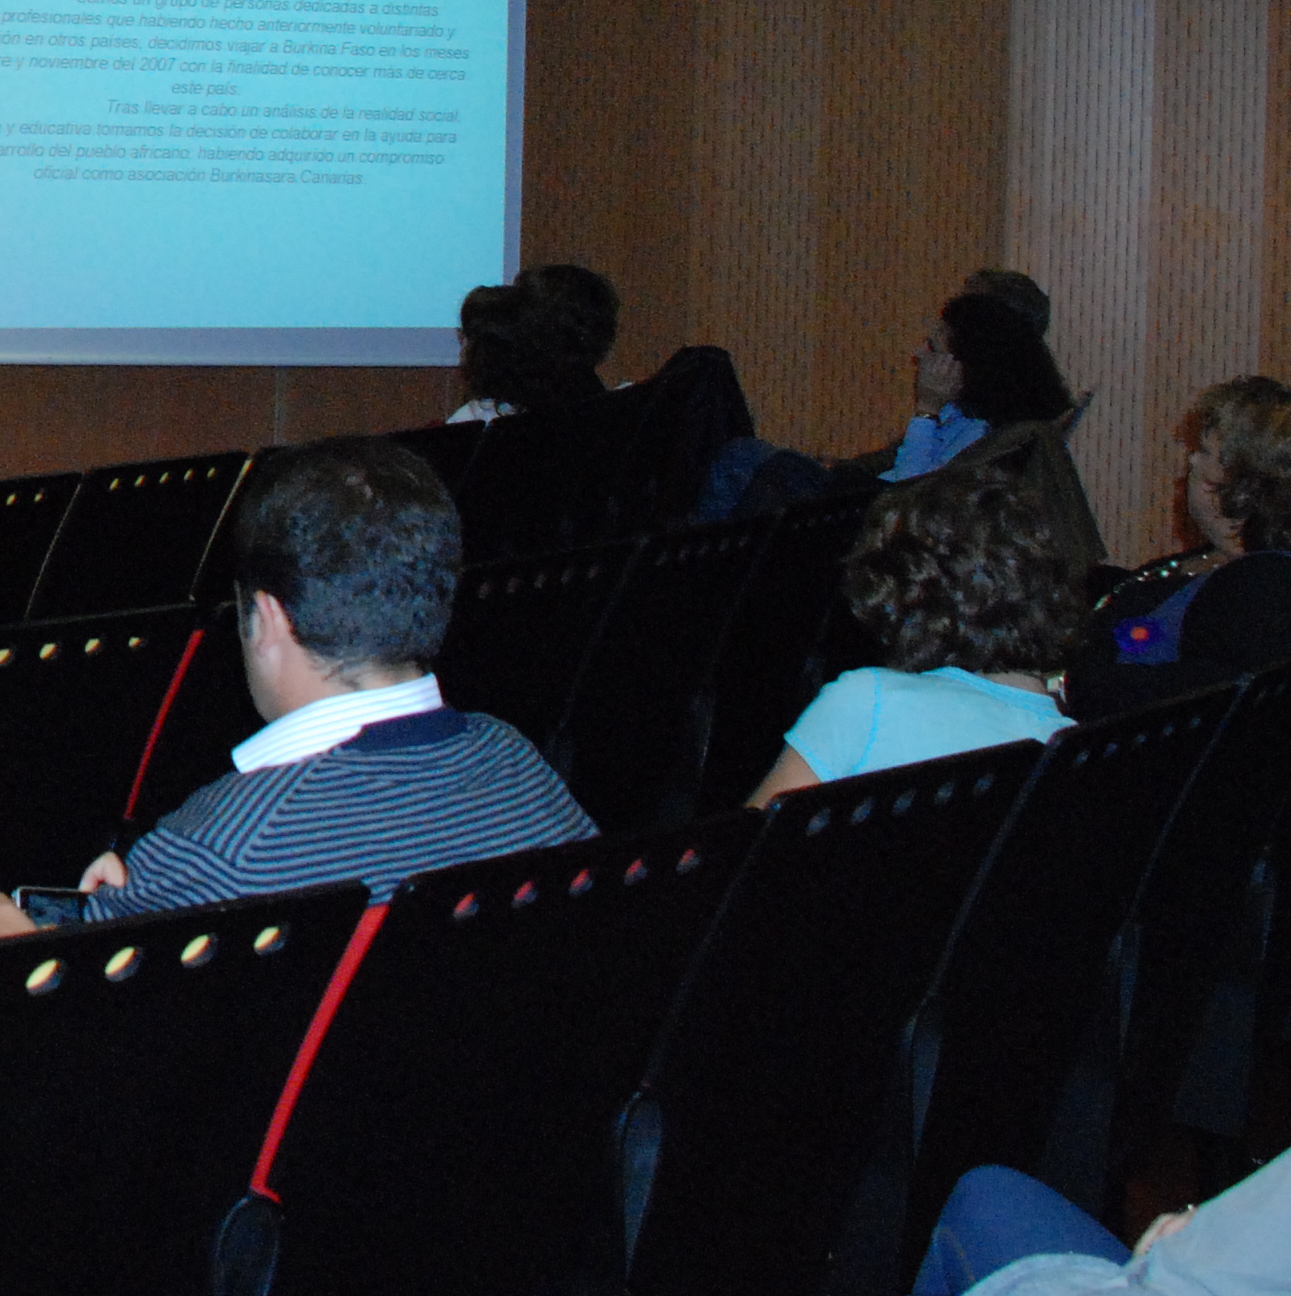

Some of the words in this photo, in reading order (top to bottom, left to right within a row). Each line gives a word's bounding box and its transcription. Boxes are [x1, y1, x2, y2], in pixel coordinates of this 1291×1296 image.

[294, 0, 364, 14] dedicadas
[382, 3, 439, 17] distintas
[1, 9, 102, 25] profesionales
[106, 15, 134, 29] que
[139, 14, 206, 29] habiendo
[209, 16, 253, 31] hecho
[257, 18, 355, 35] anteriormente
[359, 22, 444, 38] voluntariado
[25, 34, 43, 45] en
[48, 33, 85, 47] otros
[148, 36, 222, 52] decidimos
[227, 40, 266, 55] viajar
[282, 39, 336, 56] Burkina
[341, 41, 375, 57] Faso
[379, 45, 396, 58] en
[400, 44, 419, 58] los
[424, 48, 469, 60] meses
[29, 54, 109, 70] noviembre
[113, 57, 135, 71] del
[139, 57, 176, 71] 2007
[179, 60, 207, 73] con
[210, 59, 223, 73] la
[227, 60, 287, 75] finalidad
[291, 63, 309, 76] de
[313, 65, 368, 78] conocer
[406, 67, 424, 80] de
[427, 69, 465, 81] cerca
[171, 82, 203, 95] este
[107, 99, 139, 114] Tras
[144, 100, 183, 115] llevar
[201, 102, 237, 116] cabo
[241, 106, 258, 117] un
[320, 106, 338, 120] de
[342, 106, 354, 120] la
[358, 107, 414, 121] realidad
[96, 123, 164, 137] tomamos
[169, 123, 182, 137] la
[249, 125, 268, 139] de
[272, 126, 338, 141] colaborar
[342, 130, 359, 142] en
[363, 128, 376, 142] la
[380, 129, 422, 145] ayuda
[425, 132, 456, 146] para
[48, 143, 72, 157] del
[76, 145, 126, 160] pueblo
[198, 146, 263, 162] habiendo
[268, 148, 333, 165] adquirido
[337, 151, 355, 163] un
[358, 150, 444, 167] compromiso
[33, 165, 78, 180] oficial
[81, 168, 123, 181] como
[127, 167, 206, 182] asociación
